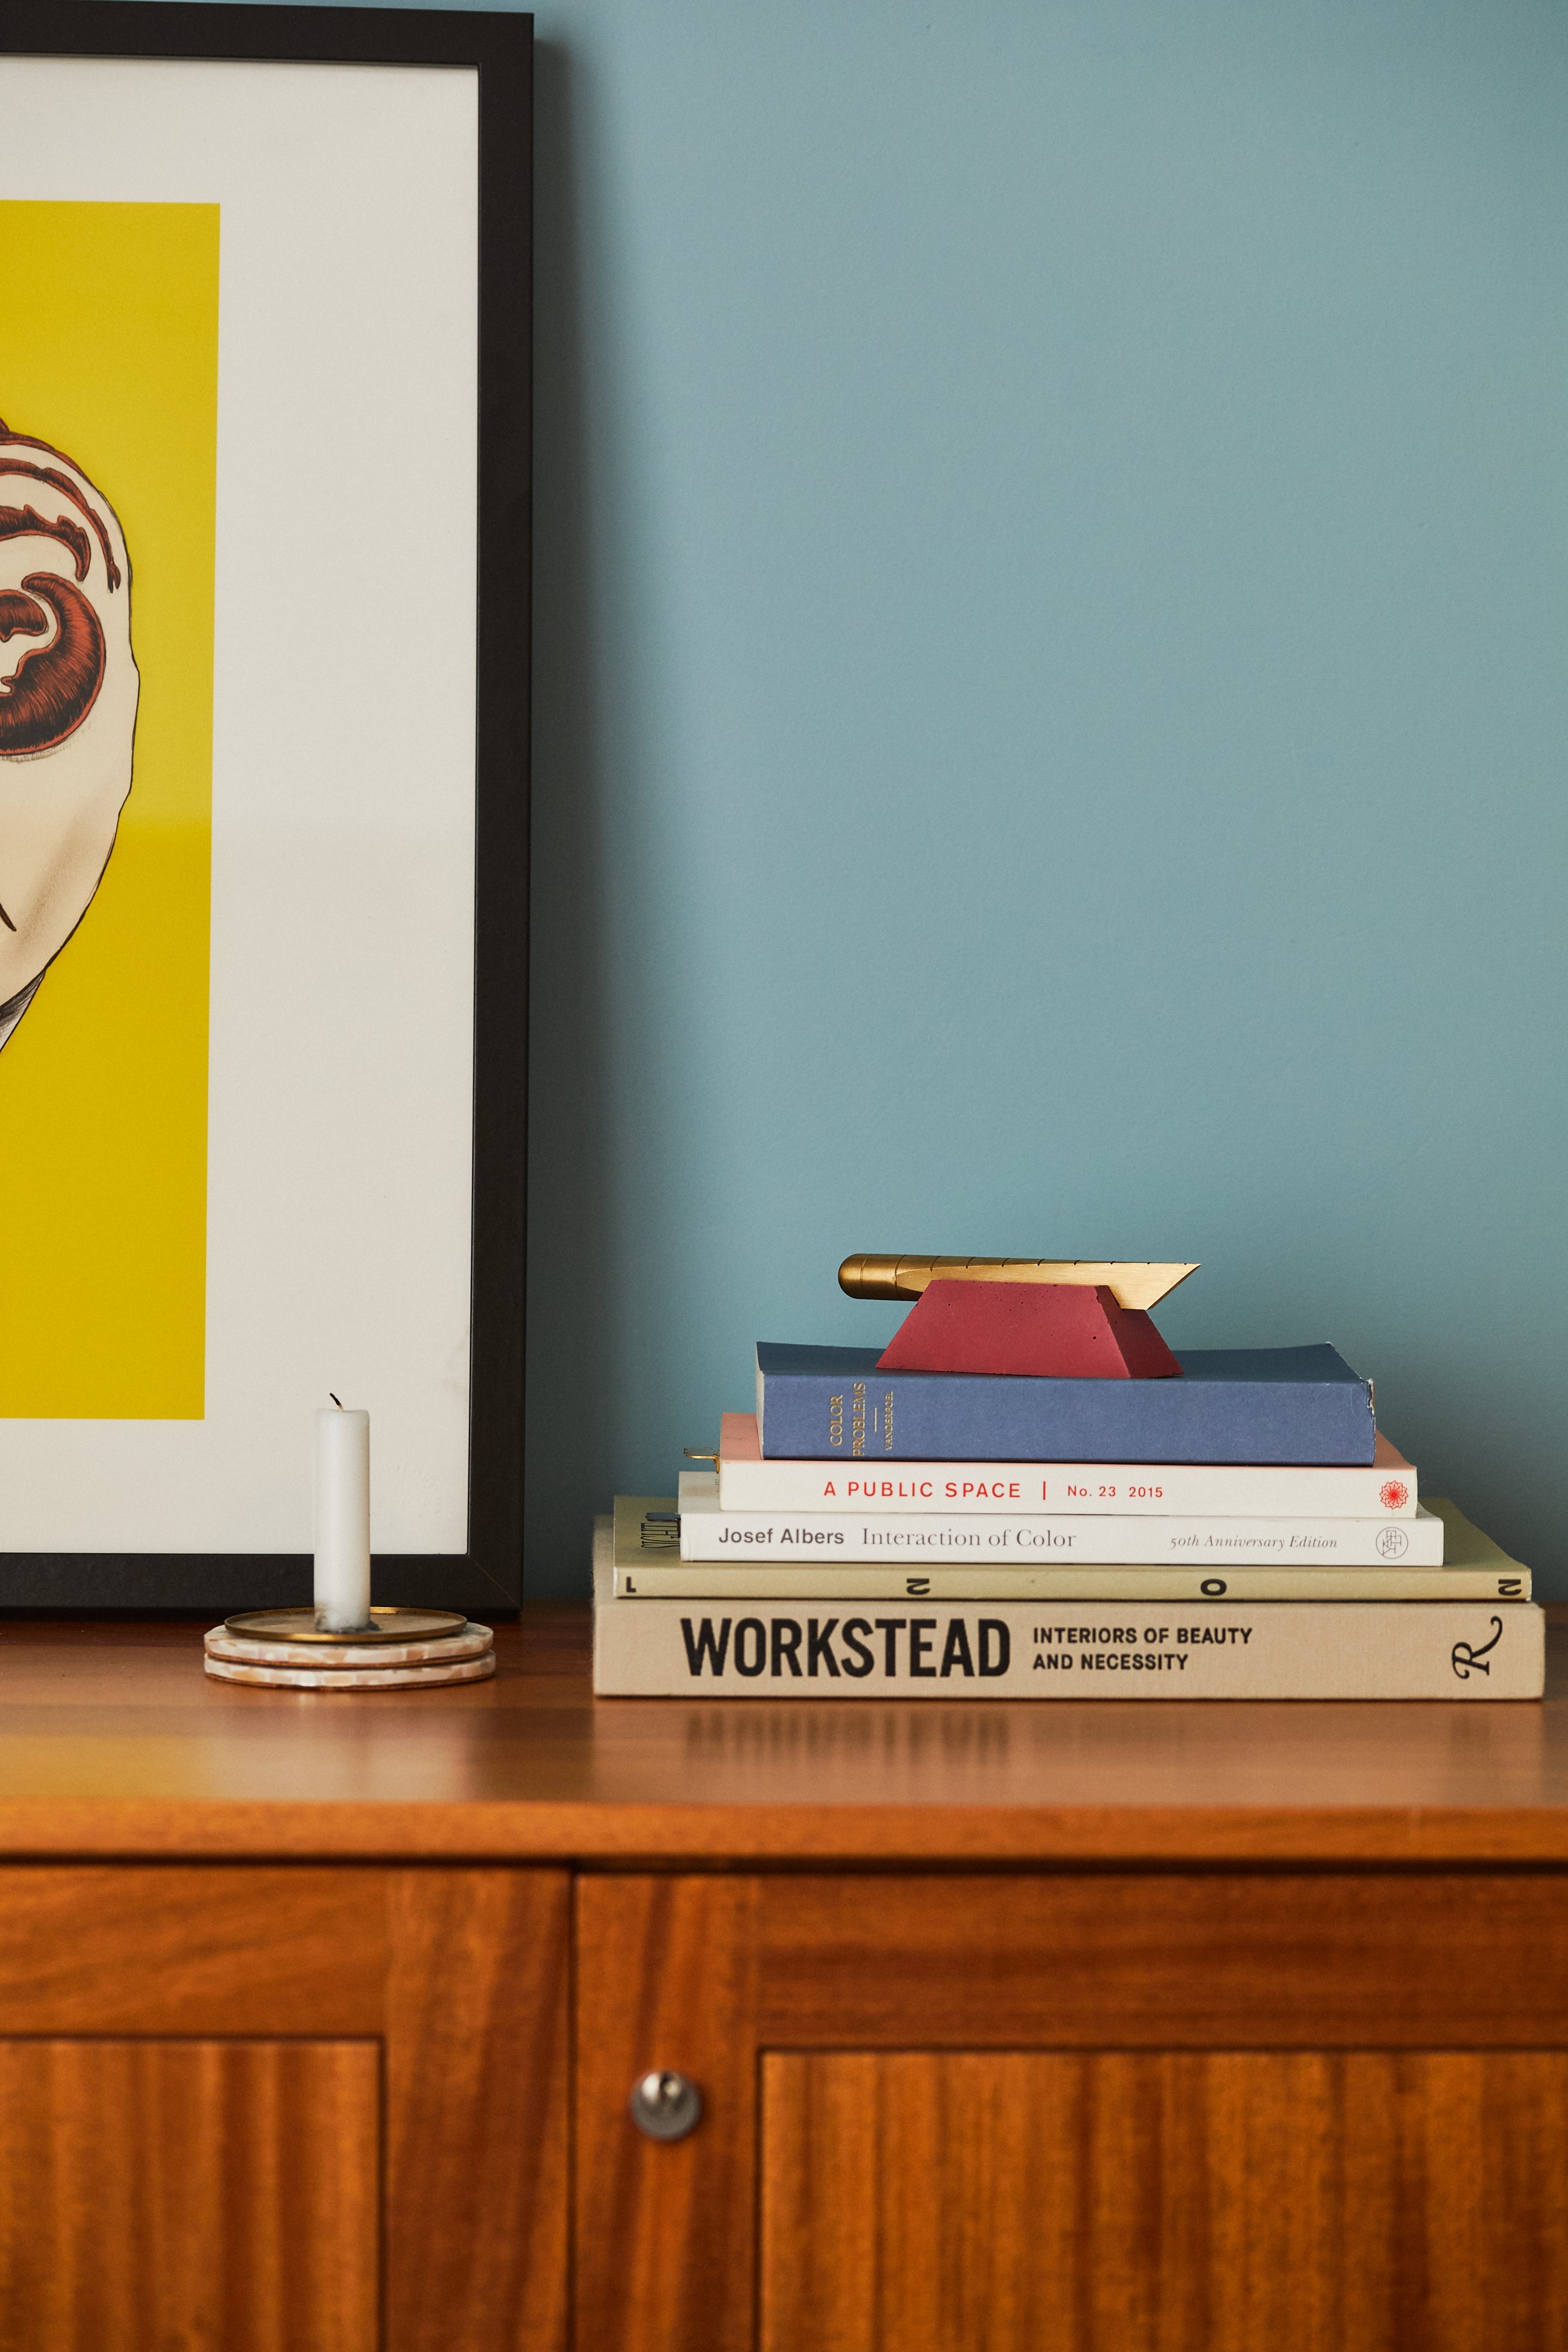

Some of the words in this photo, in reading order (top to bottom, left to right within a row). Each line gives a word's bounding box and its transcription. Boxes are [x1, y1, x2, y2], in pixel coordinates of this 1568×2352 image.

[830, 1394, 843, 1446] COLOR
[852, 1382, 865, 1456] PROBLEMS
[885, 1391, 893, 1451] VANDERPOEL
[824, 1482, 835, 1495] A
[848, 1482, 932, 1497] PUBLIC
[945, 1482, 1020, 1498] SPACE
[1068, 1486, 1091, 1496] No.
[1099, 1486, 1115, 1496] 23
[1129, 1487, 1162, 1497] 2015
[719, 1528, 773, 1543] Josef
[781, 1529, 844, 1544] Albers
[864, 1528, 979, 1545] Interaction
[989, 1529, 1011, 1546] of
[1017, 1530, 1076, 1546] Color
[1171, 1534, 1199, 1549] 50th
[1204, 1535, 1285, 1552] Anniversary
[1289, 1535, 1338, 1549] Edition
[680, 1618, 1010, 1678] WORKSTEAD
[1034, 1628, 1137, 1643] INTERIORS
[1144, 1628, 1169, 1643] OF
[1177, 1628, 1252, 1644] BEAUTY
[1033, 1653, 1073, 1670] AND
[1081, 1653, 1188, 1670] NECESSITY
